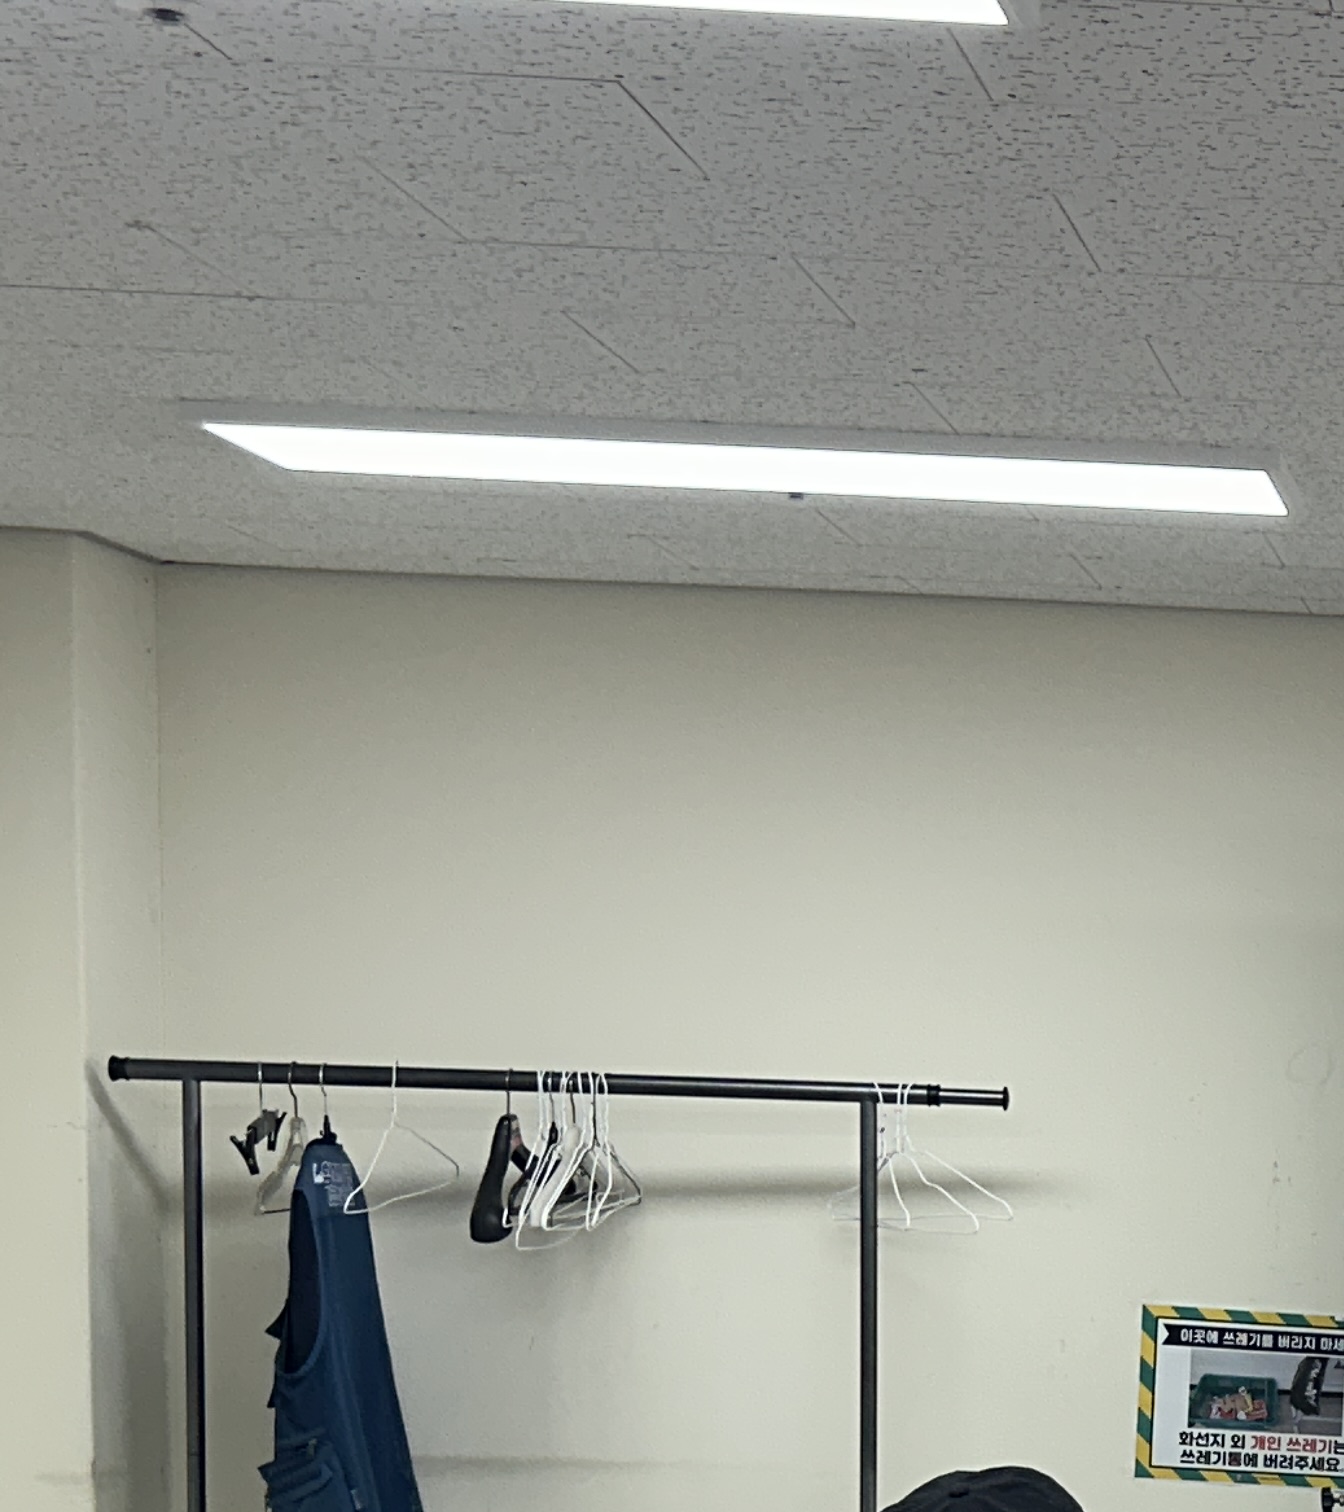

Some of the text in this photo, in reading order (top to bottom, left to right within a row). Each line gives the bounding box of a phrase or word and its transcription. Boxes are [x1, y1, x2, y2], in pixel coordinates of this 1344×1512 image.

[1180, 1328, 1219, 1344] 이곳에
[1223, 1332, 1274, 1348] 쓰레기를
[1278, 1335, 1316, 1350] 버리지
[1179, 1432, 1225, 1448] 화선지
[1231, 1434, 1245, 1450] 외
[1251, 1435, 1281, 1451] 개인
[1180, 1450, 1258, 1468] 쓰레기통에
